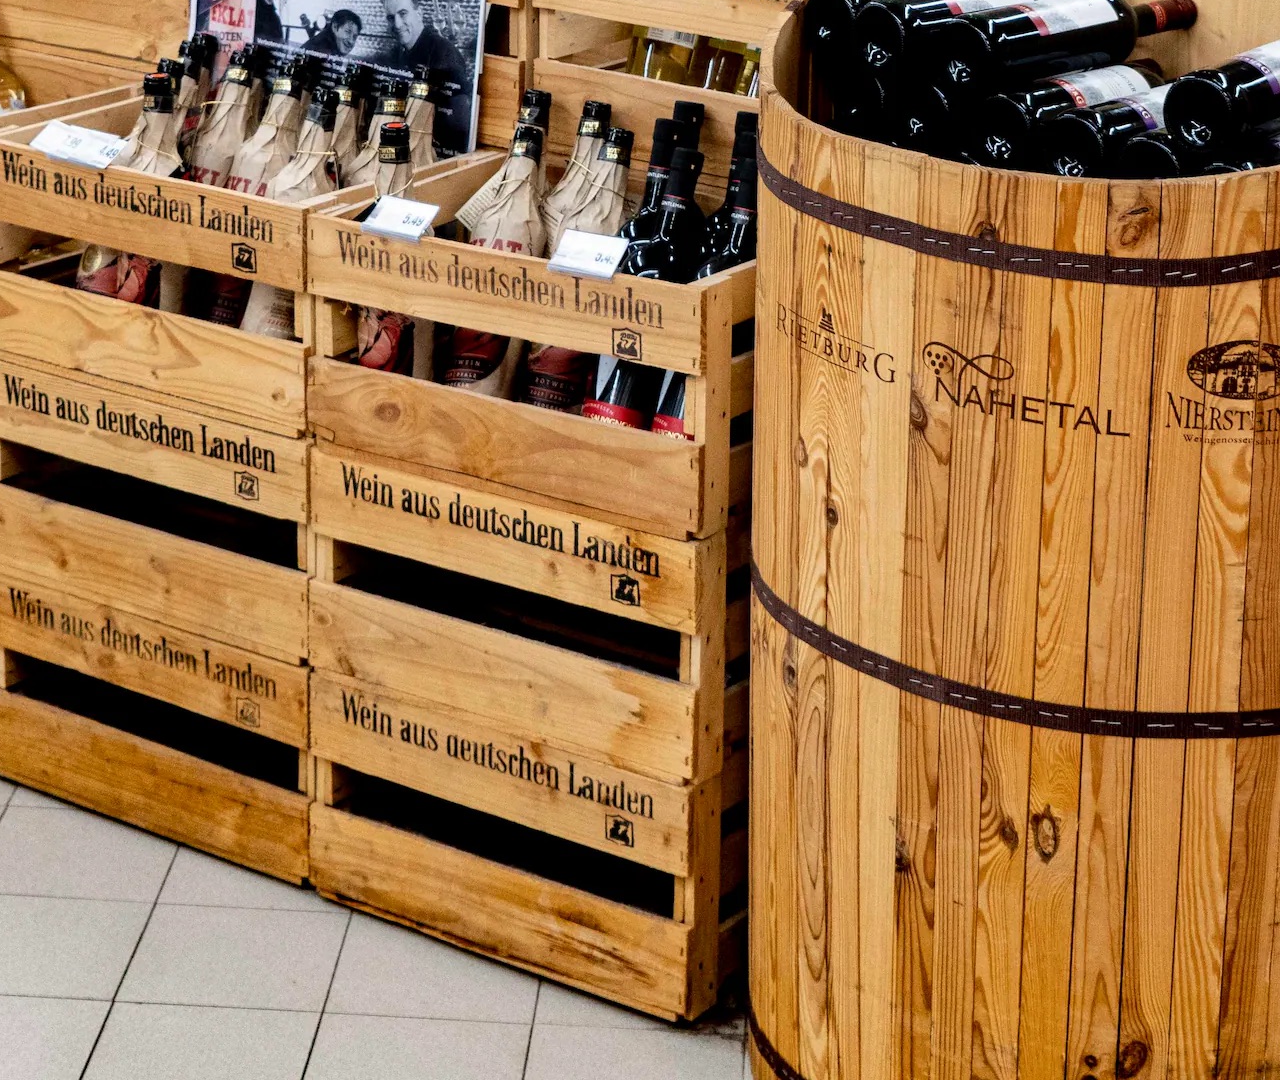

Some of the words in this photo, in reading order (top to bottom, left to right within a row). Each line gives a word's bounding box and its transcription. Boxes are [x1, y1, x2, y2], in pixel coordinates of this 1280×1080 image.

[1, 150, 49, 194] Wein
[54, 168, 88, 204] aus
[93, 172, 194, 227] deutschen
[197, 194, 274, 245] Landen
[336, 230, 393, 275] Wein
[398, 250, 439, 284] aus
[446, 255, 565, 310] deutschen
[571, 276, 665, 331] Landen
[774, 301, 897, 384] RIETBURG
[5, 375, 51, 417] Wein
[56, 395, 90, 424] aus
[96, 401, 195, 455] deutschen
[200, 423, 277, 474] Landen
[934, 375, 1131, 438] NAHETAL
[340, 461, 395, 509] Wein
[401, 488, 441, 521] aus
[448, 492, 565, 553] deutschen
[571, 521, 661, 579] Landen
[9, 587, 56, 630] Wein
[60, 608, 95, 641] aus
[101, 617, 199, 672] deutschen
[202, 647, 277, 700] Landen
[340, 689, 393, 739] Wein
[399, 718, 439, 752] aus
[567, 760, 656, 820] Landen
